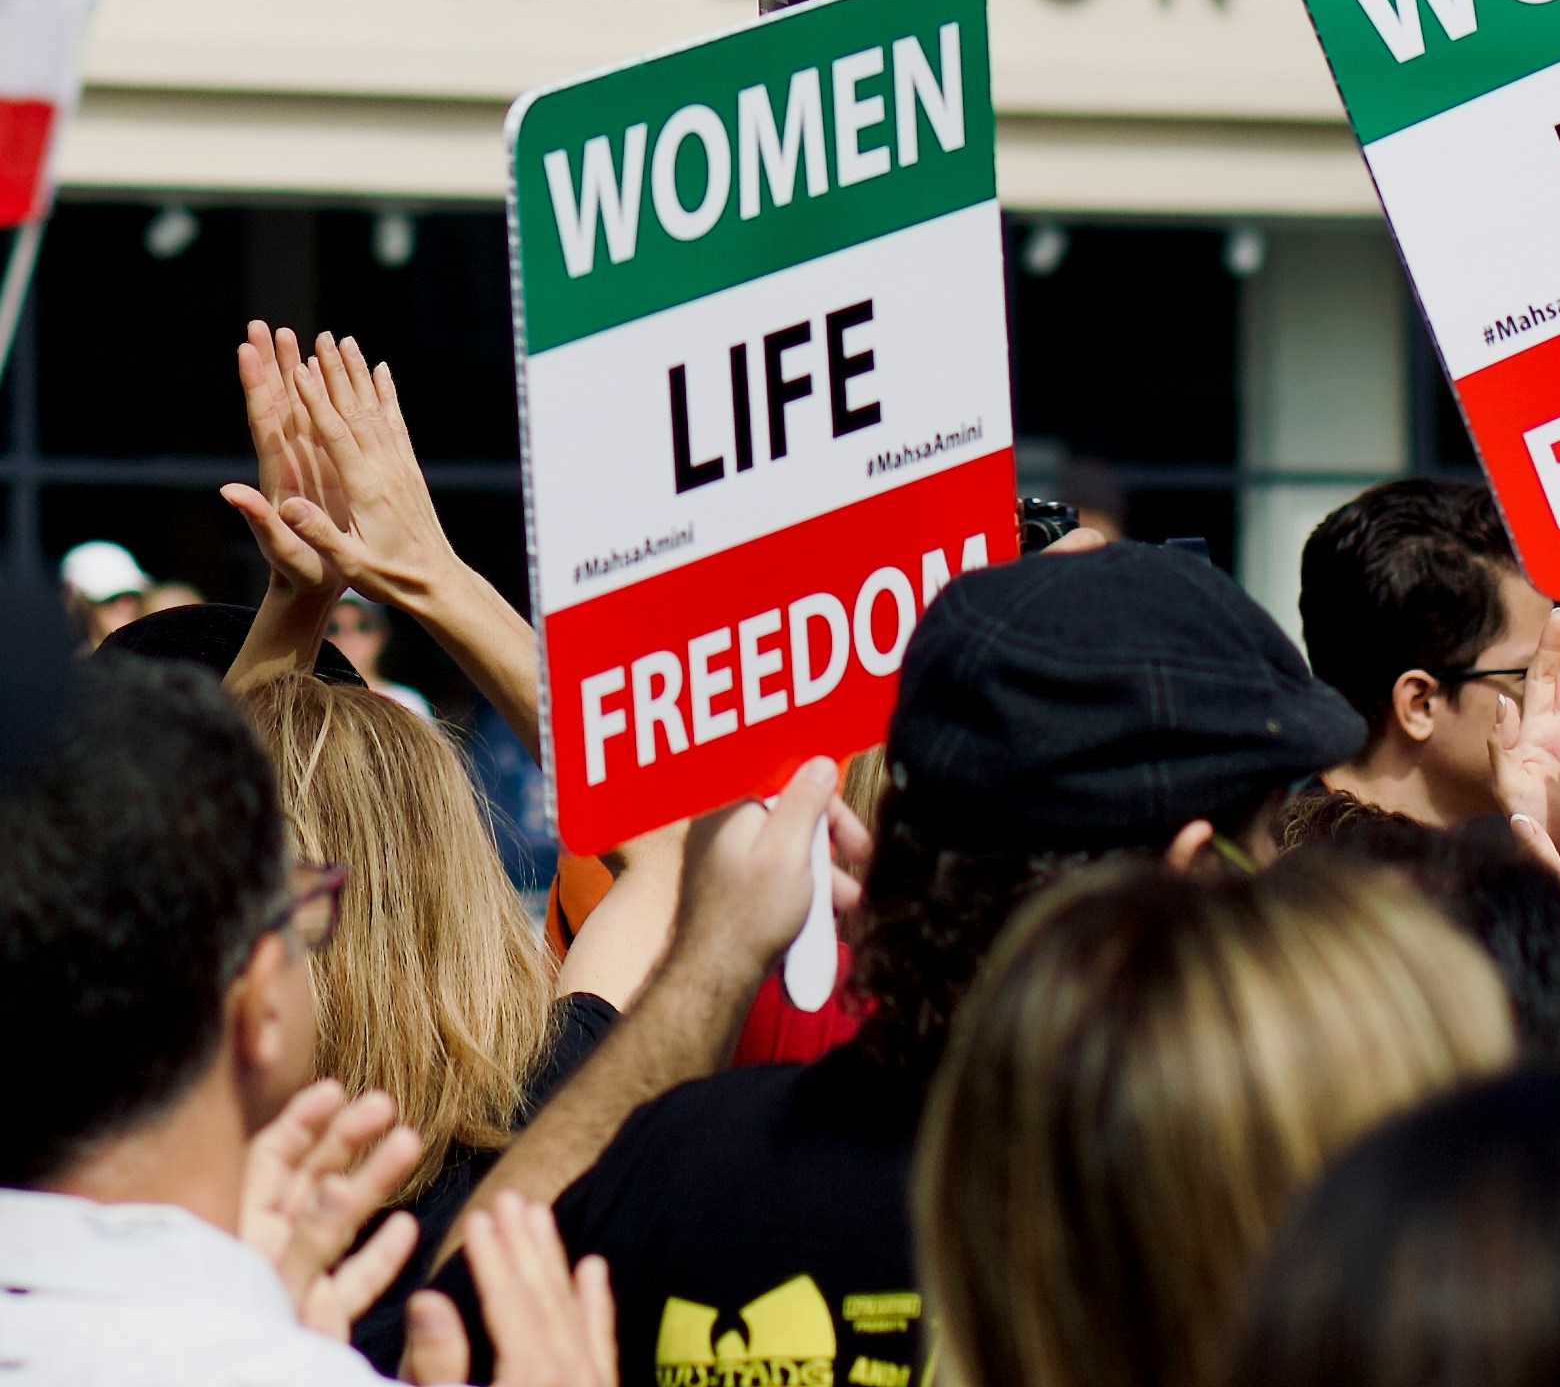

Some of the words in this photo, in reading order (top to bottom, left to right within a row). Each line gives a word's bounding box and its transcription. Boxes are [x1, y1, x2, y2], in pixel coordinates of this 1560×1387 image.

[543, 22, 966, 279] WOMEN
[668, 298, 883, 495] LIFE
[867, 416, 984, 478] #MahsaAmini
[574, 520, 695, 584] #MahsaAmini
